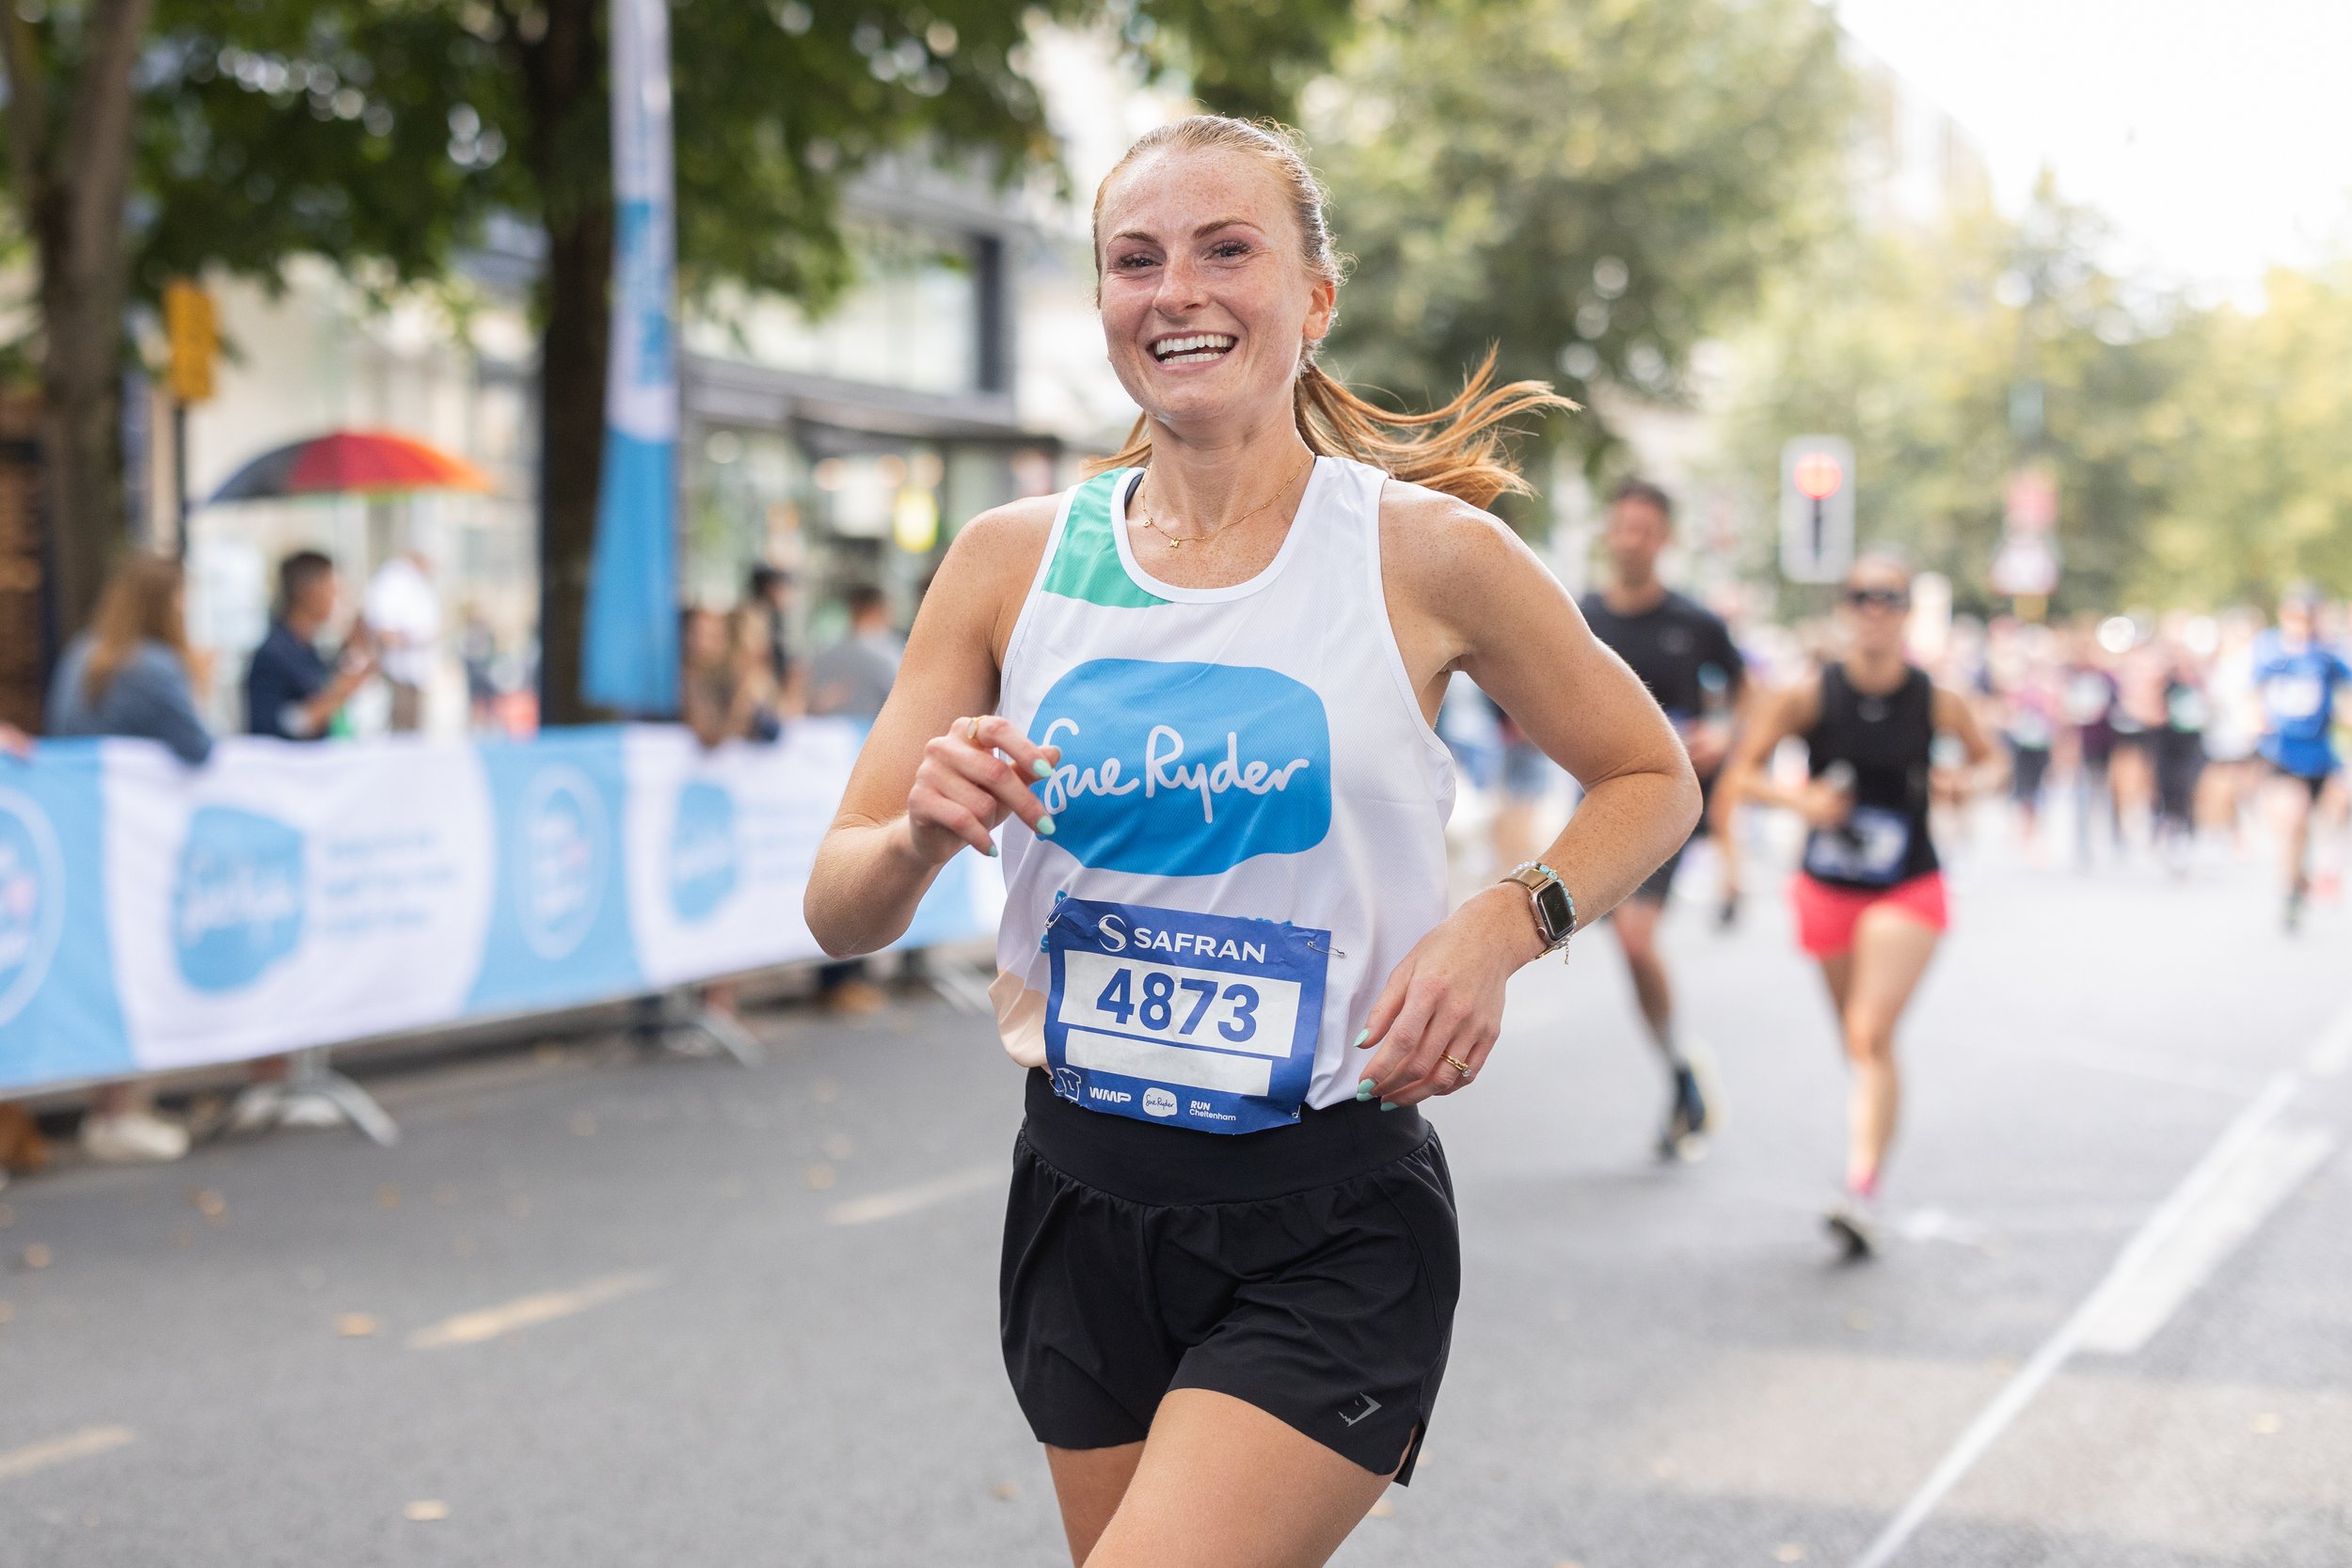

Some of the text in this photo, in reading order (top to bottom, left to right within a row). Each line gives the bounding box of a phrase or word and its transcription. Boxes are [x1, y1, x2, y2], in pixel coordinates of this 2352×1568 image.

[1145, 725, 1310, 824] Ryder
[1133, 927, 1266, 964] SAFRAN
[1095, 967, 1260, 1043] 4873
[1089, 1086, 1132, 1103] WMP
[1145, 1094, 1175, 1110] Sue Ryder
[1188, 1108, 1236, 1121] Cheltenham
[1190, 1101, 1211, 1111] RUN
